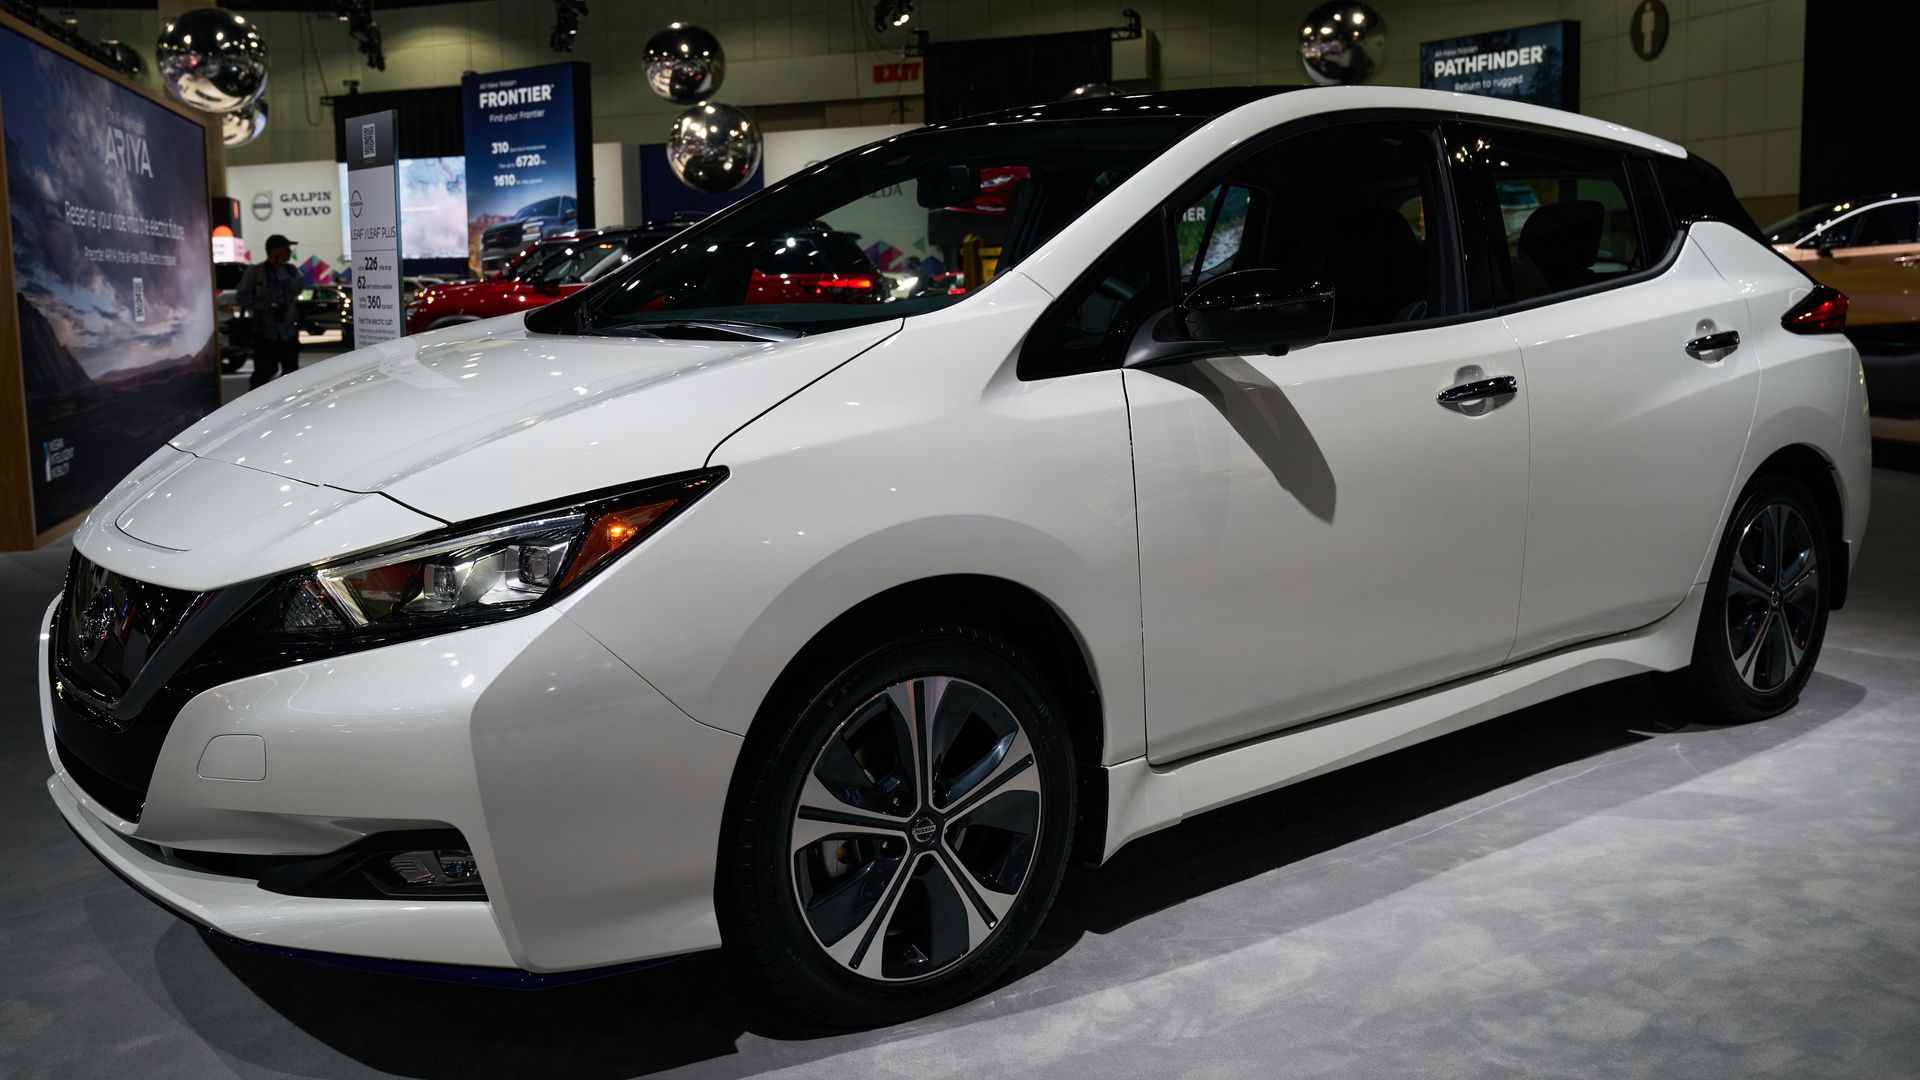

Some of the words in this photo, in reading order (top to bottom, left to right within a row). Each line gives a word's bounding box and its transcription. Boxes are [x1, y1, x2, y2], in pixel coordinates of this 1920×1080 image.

[1434, 45, 1543, 78] PATHFINDER
[873, 63, 921, 83] EXIT
[1454, 80, 1481, 92] Return
[1482, 79, 1492, 89] to
[1493, 74, 1523, 87] rugged
[479, 84, 552, 109] FRONTIER
[489, 113, 503, 123] Find
[504, 113, 519, 123] your
[519, 109, 545, 120] Frontier
[104, 126, 153, 178] ARIYA
[491, 141, 509, 154] 310
[515, 154, 541, 168] 6720
[493, 174, 516, 187] 1610
[280, 191, 331, 203] GALPIN
[282, 206, 331, 217] VOLVO
[351, 228, 364, 240] LEAF
[381, 226, 396, 238] PLUS
[365, 257, 378, 270] 226
[357, 276, 366, 289] 62
[367, 295, 381, 309] 360
